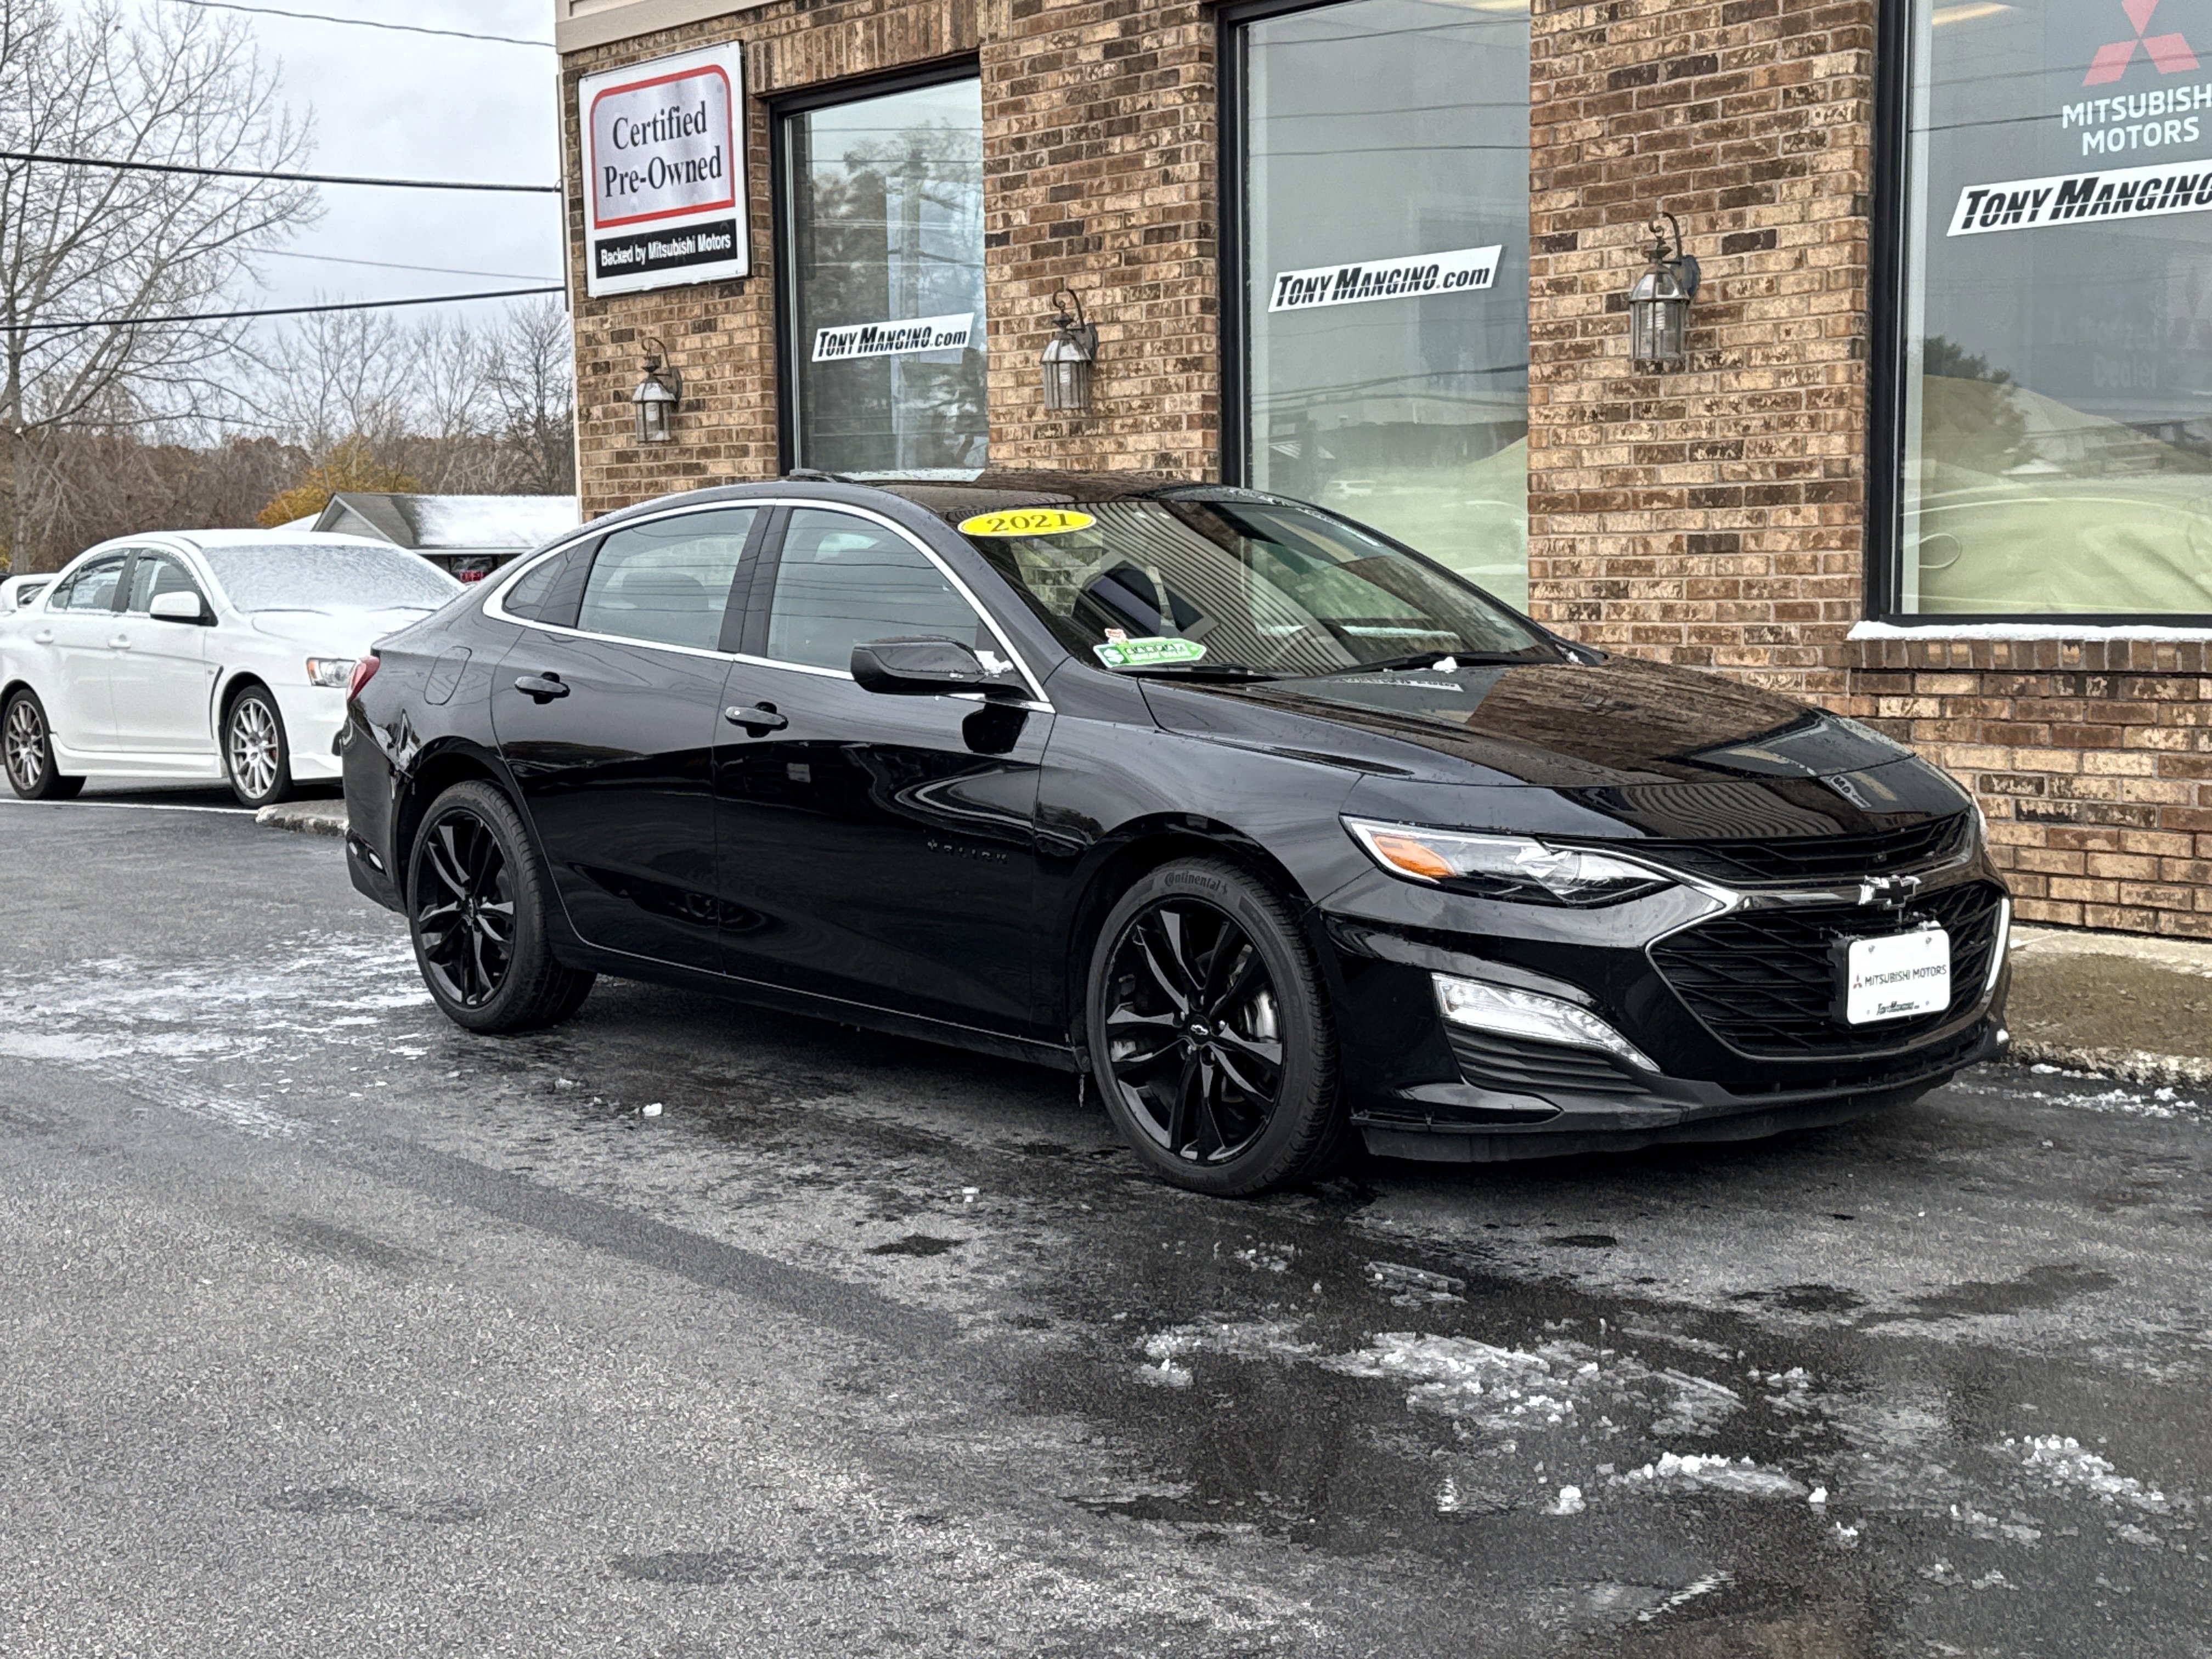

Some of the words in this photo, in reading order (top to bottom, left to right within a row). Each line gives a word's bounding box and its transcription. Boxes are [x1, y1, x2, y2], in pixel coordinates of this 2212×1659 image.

[2062, 83, 2212, 129] MITSUBISH
[612, 100, 707, 150] Certified
[2082, 117, 2200, 156] MOTORS
[603, 145, 723, 198] Pre-Owned
[601, 247, 633, 267] Backed
[635, 241, 646, 266] by
[648, 236, 696, 260] Mitsubishi
[697, 233, 731, 252] Motors
[986, 513, 1073, 533] 2021
[1165, 871, 1221, 892] Continental
[1865, 969, 1910, 987] MITSUBISHI
[1912, 964, 1948, 980] MOTORS
